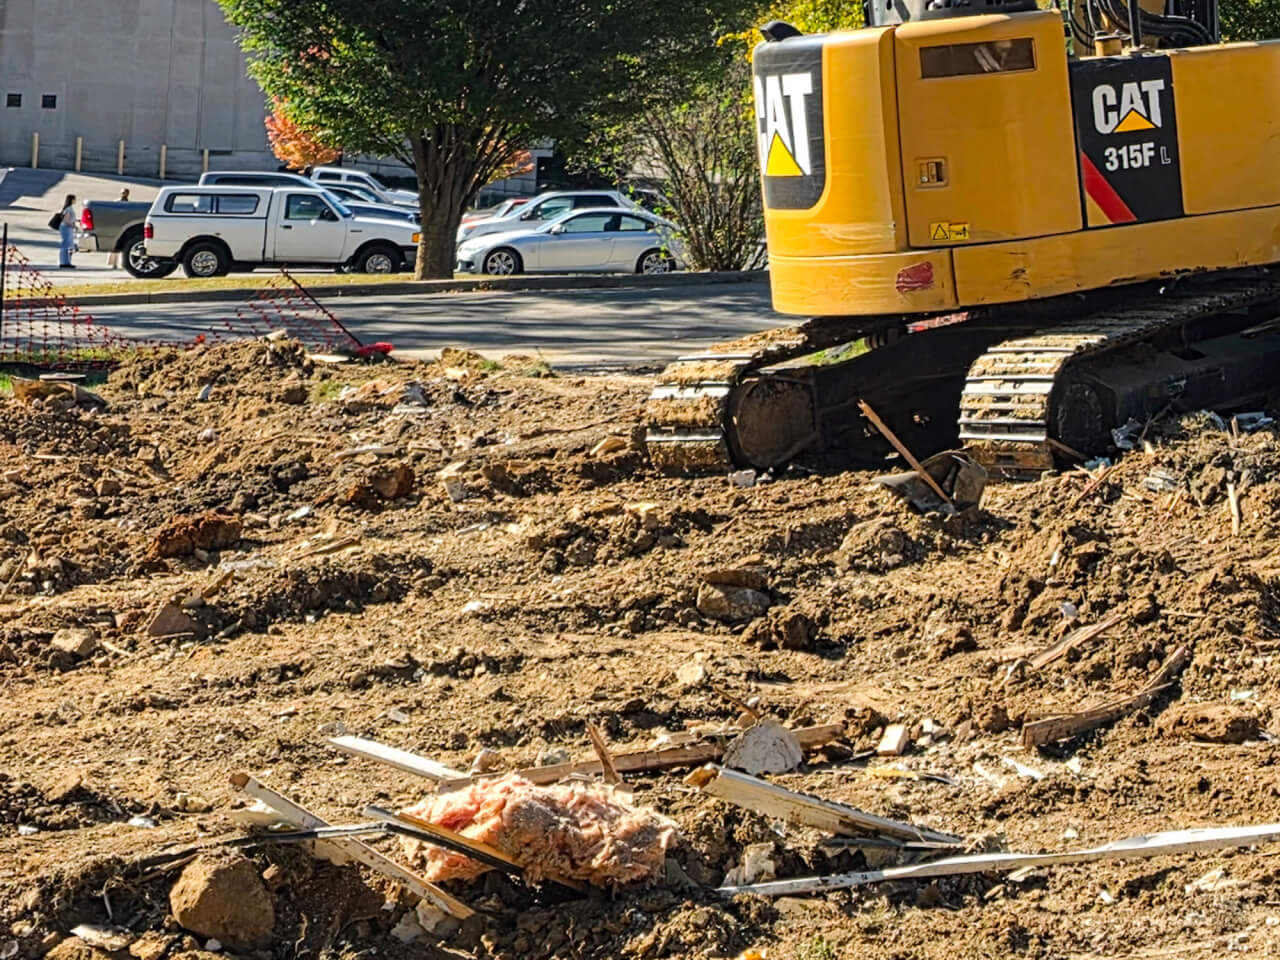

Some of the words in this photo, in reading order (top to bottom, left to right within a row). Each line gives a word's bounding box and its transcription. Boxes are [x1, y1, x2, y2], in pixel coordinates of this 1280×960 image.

[1092, 79, 1165, 134] CAT
[1104, 142, 1155, 171] 315F
[1160, 146, 1171, 164] L
